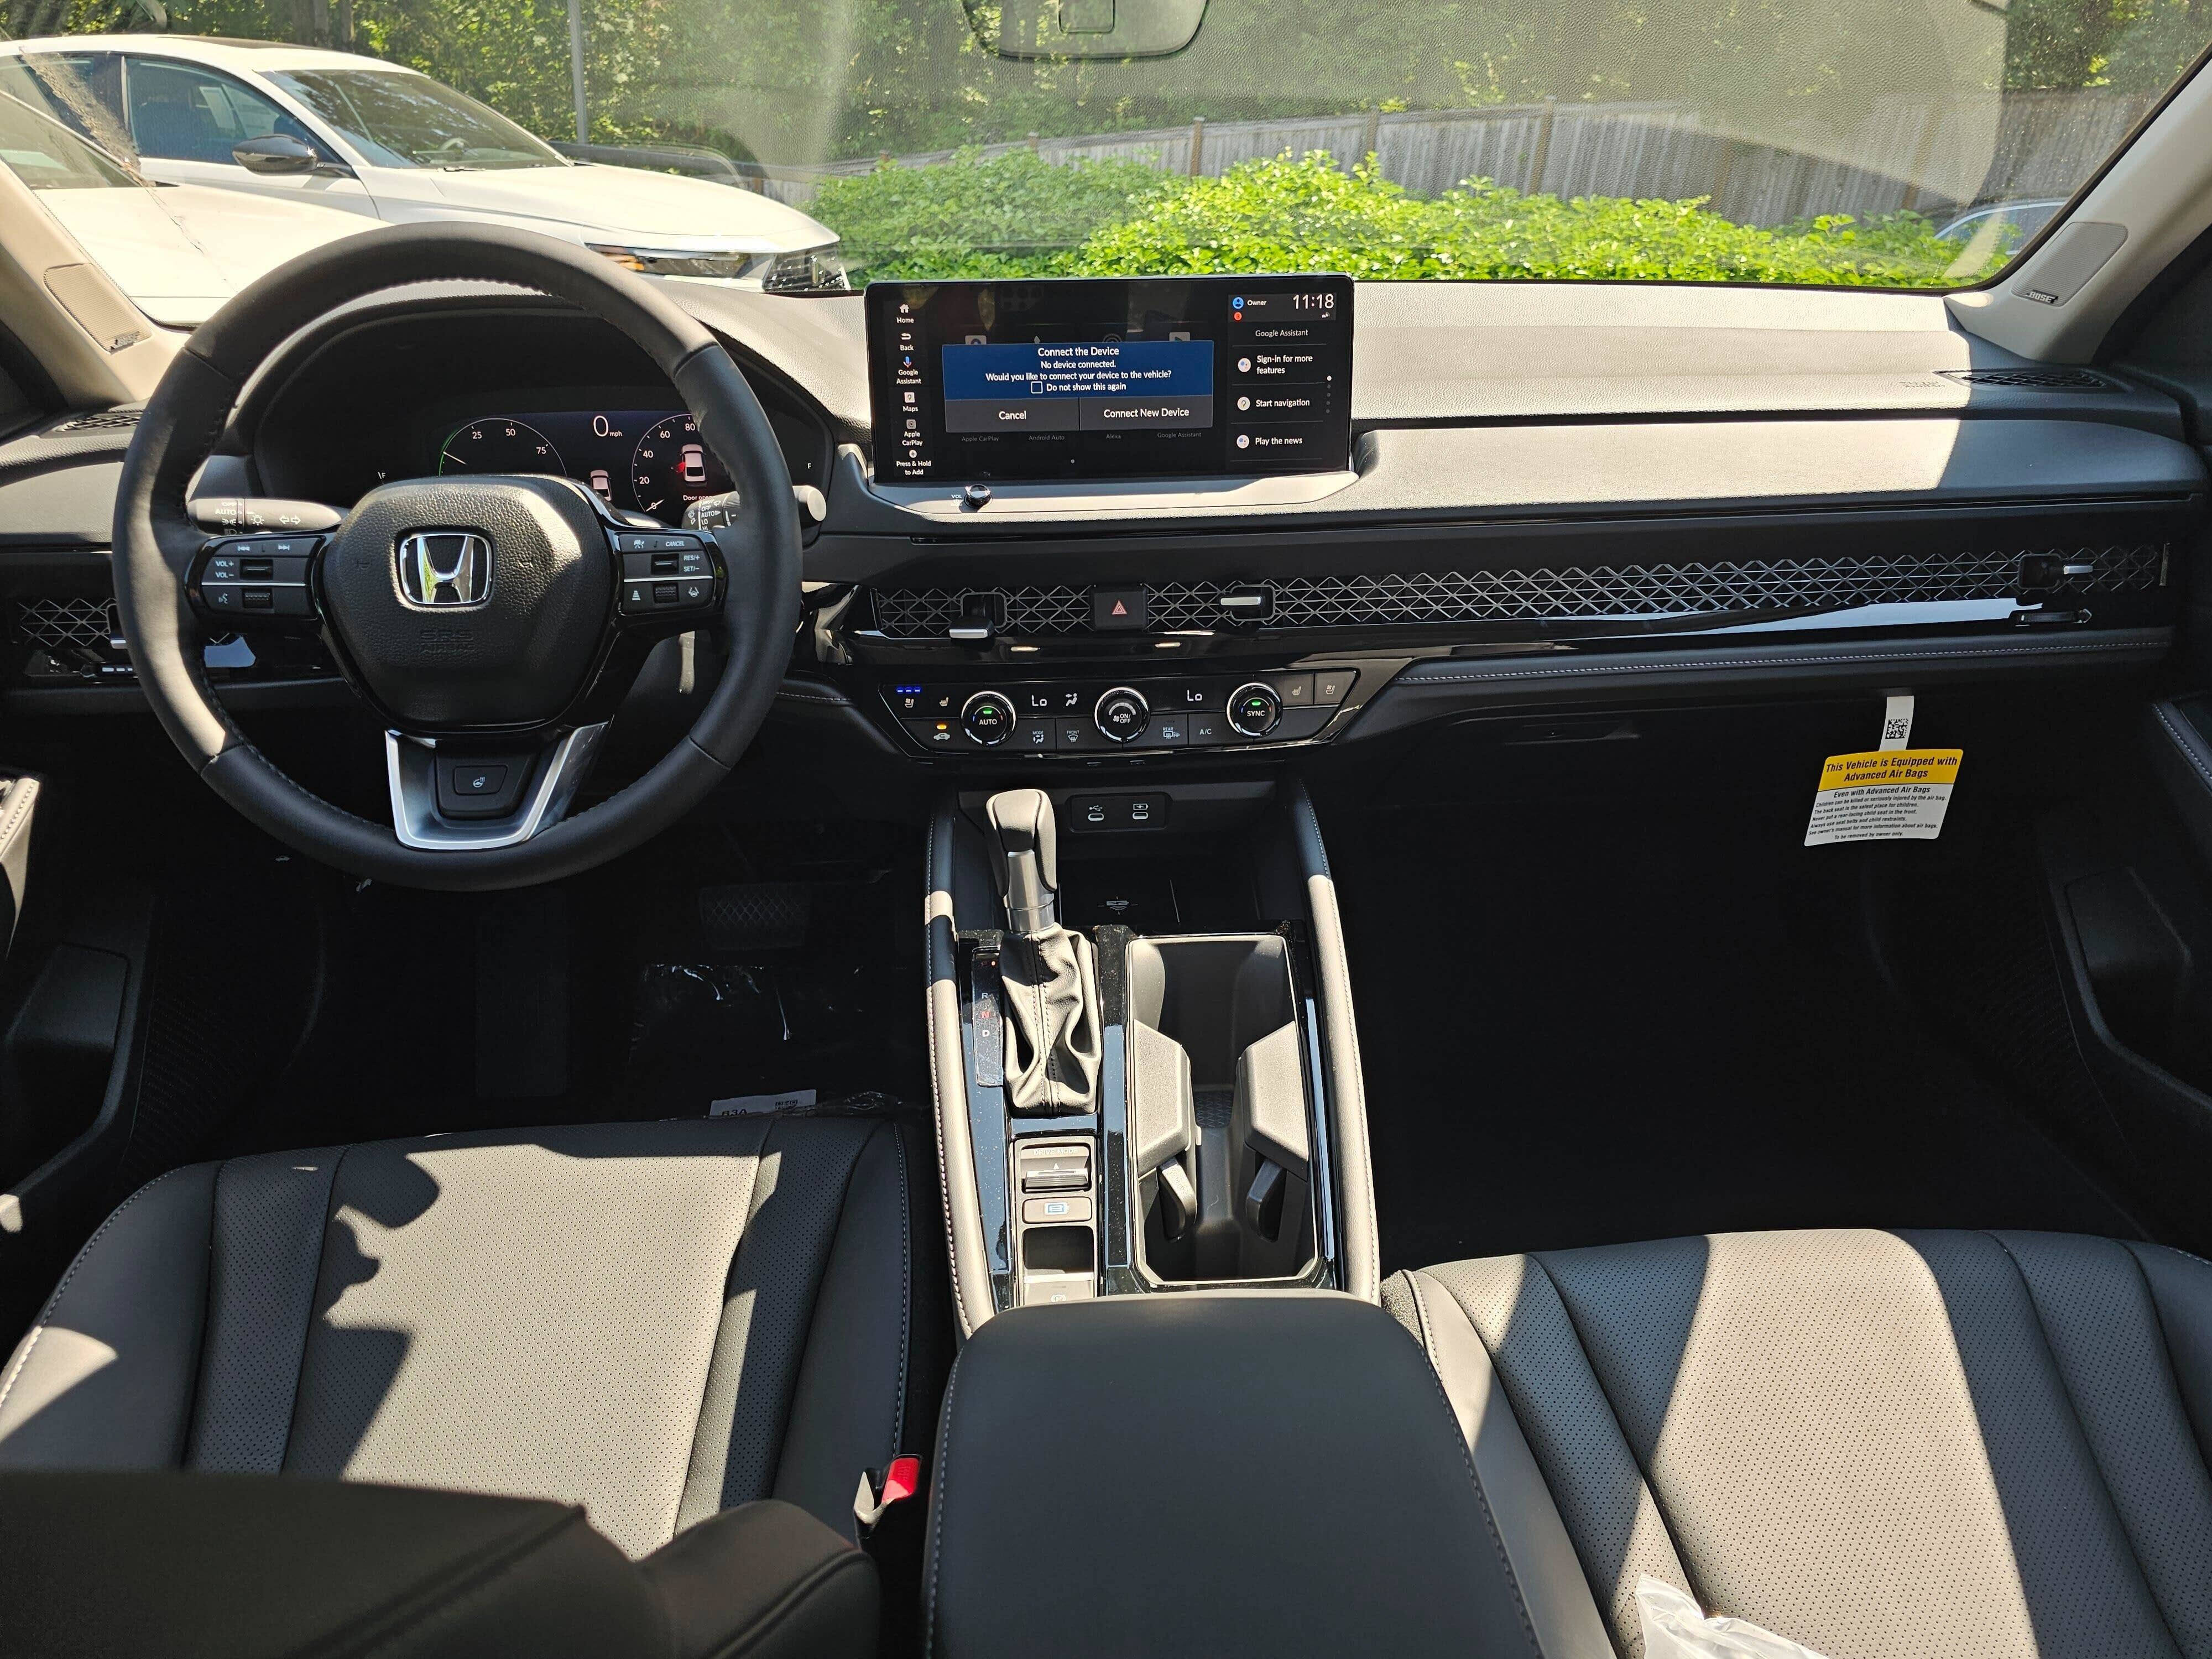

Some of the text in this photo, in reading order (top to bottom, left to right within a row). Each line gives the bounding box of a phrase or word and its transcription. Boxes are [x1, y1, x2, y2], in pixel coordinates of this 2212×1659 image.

[1293, 294, 1334, 310] 11:18
[2029, 291, 2056, 303] BOSE
[1037, 346, 1120, 357] Connect the Device
[1041, 359, 1117, 369] No device connected.
[1256, 354, 1281, 364] Sign-in
[1256, 366, 1286, 374] features
[985, 372, 1009, 381] Would
[1026, 372, 1039, 380] like
[1049, 372, 1077, 380] connect
[1078, 373, 1095, 381] your
[1096, 371, 1120, 379] device
[1130, 370, 1142, 379] the
[1143, 370, 1172, 379] vehicle?
[1046, 383, 1057, 392] Do
[1072, 383, 1091, 391] show
[1107, 382, 1126, 392] again
[1274, 398, 1310, 408] navigation
[999, 410, 1027, 420] Cancel
[1103, 408, 1190, 418] Connect New Device
[593, 415, 608, 437] 0
[685, 423, 695, 431] 80
[1255, 437, 1270, 446] Play
[536, 446, 546, 455] 75
[643, 450, 654, 458] 40
[1827, 757, 1957, 773] This Vehicle is Equipped with
[1844, 769, 1928, 782] Advanced Air Bags
[1866, 786, 1900, 795] Advanced
[1913, 786, 1931, 794] Bags
